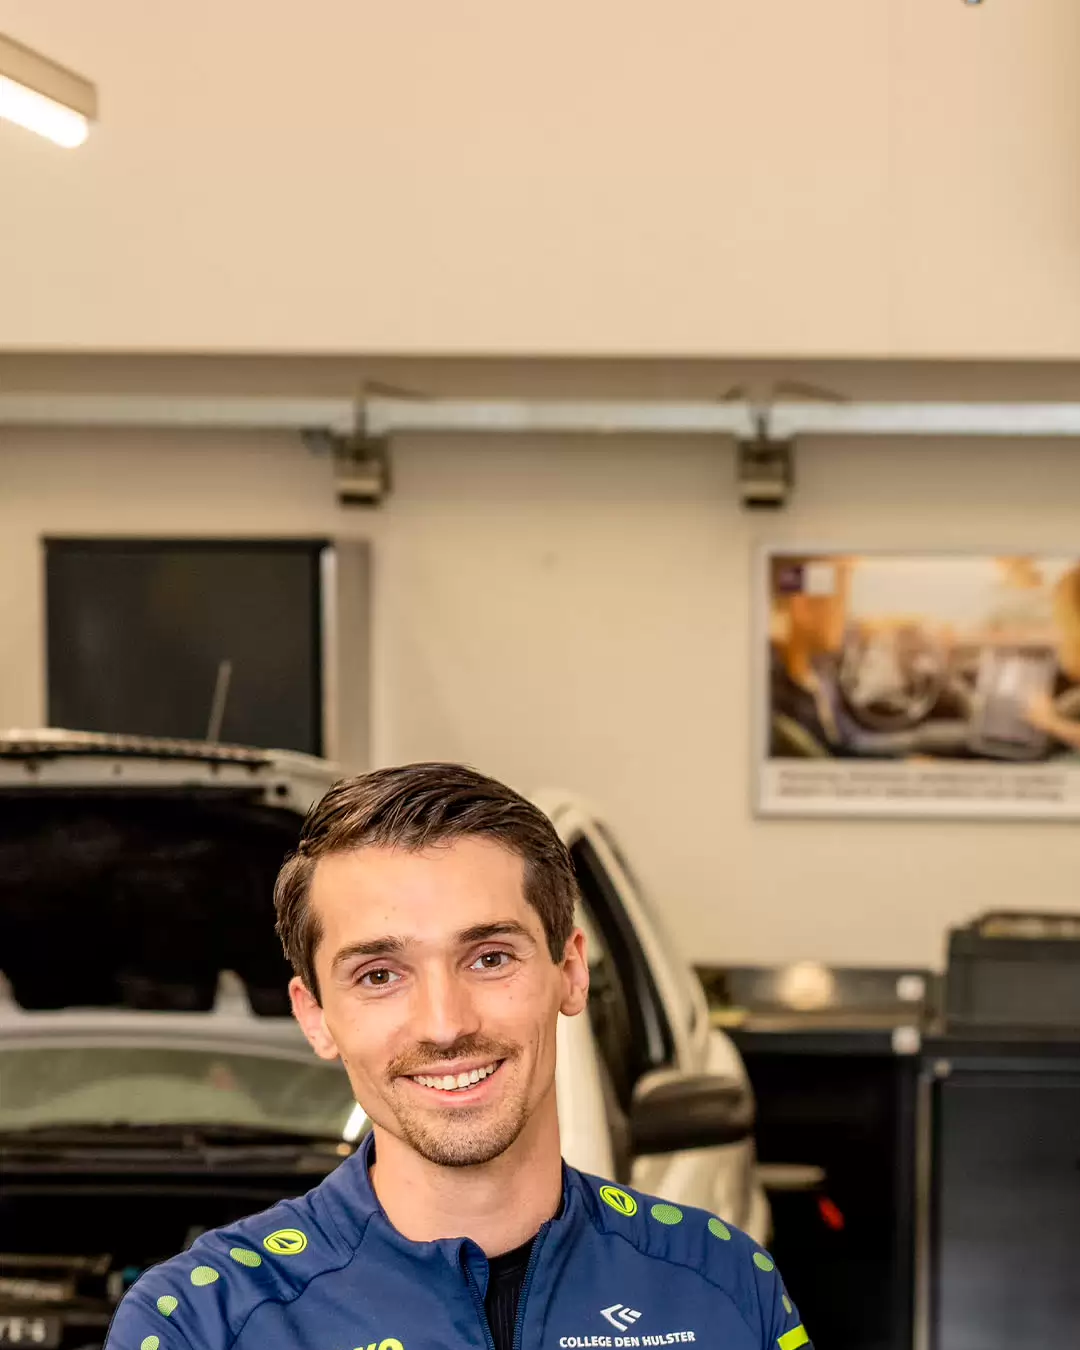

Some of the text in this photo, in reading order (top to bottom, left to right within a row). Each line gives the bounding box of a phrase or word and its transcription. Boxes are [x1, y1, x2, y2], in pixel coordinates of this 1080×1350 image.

[559, 1331, 696, 1349] COLLEGE DEN HULSTER
